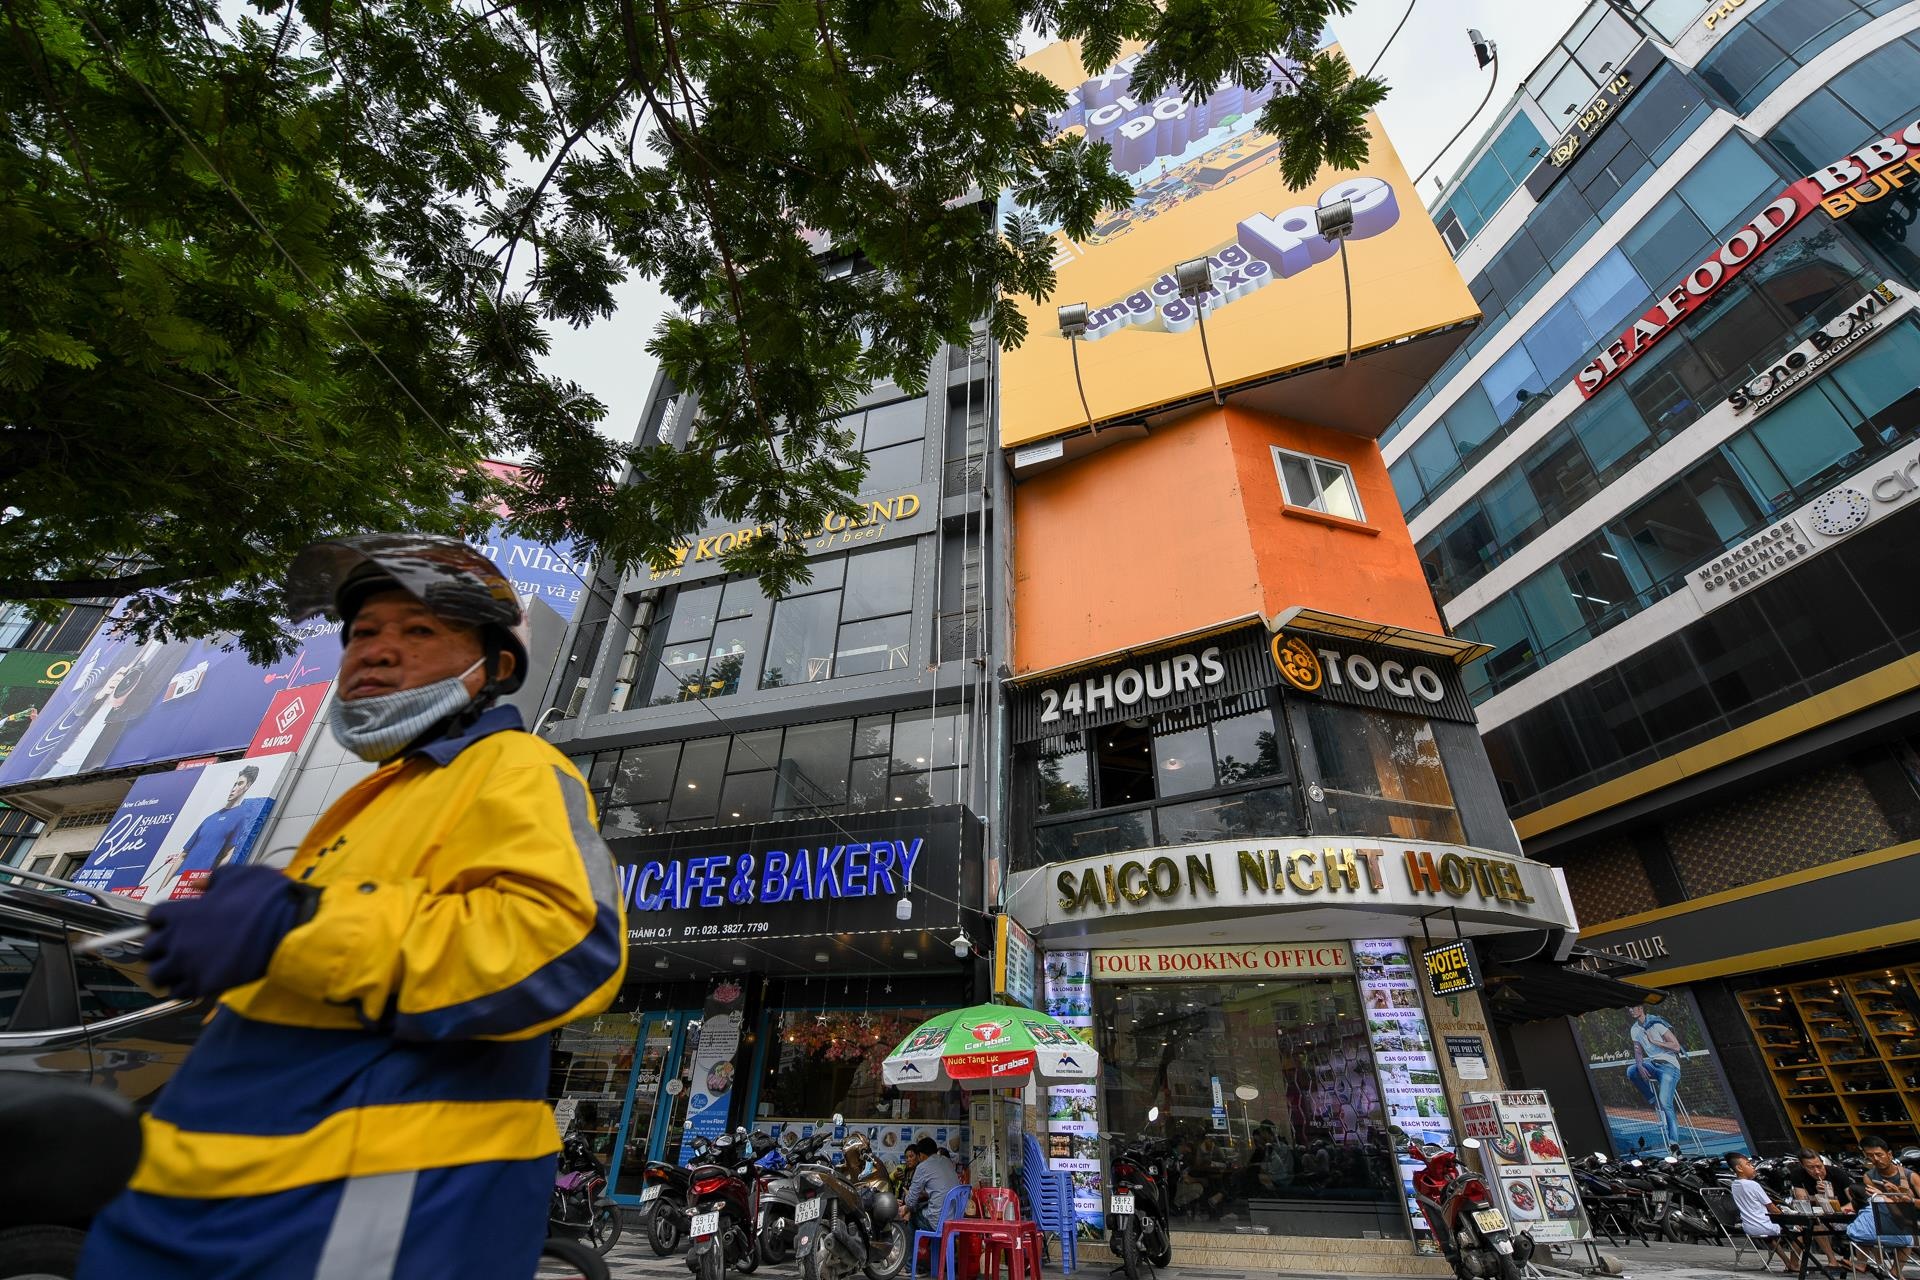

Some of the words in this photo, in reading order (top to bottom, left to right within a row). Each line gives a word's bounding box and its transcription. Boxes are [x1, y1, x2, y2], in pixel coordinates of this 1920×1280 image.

[1607, 74, 1630, 96] Vu
[1238, 177, 1399, 263] be
[1151, 243, 1250, 298] dng
[1219, 260, 1270, 292] xe
[1578, 197, 1797, 393] SEAFOOD
[1753, 369, 1807, 412] Japanese
[1807, 320, 1874, 372] Restaurant
[782, 494, 921, 543] GEND
[816, 531, 838, 549] of
[841, 523, 886, 544] beef
[1698, 521, 1795, 581] WORKSPACE
[1704, 532, 1798, 592] COMMUNITY
[1728, 542, 1809, 593] SERVICES
[546, 584, 566, 598] và
[1040, 646, 1226, 724] 24HOURS
[1318, 648, 1445, 704] TOGO
[261, 734, 293, 749] SAVICO
[122, 801, 135, 809] New
[134, 798, 160, 808] Collection
[134, 825, 148, 837] OF
[140, 813, 175, 827] SHADES
[94, 813, 147, 866] Blue
[760, 838, 924, 903] BAKERY
[1057, 852, 1218, 911] SAIGON
[1237, 847, 1385, 896] NIGHT
[1403, 850, 1536, 905] HOTEL
[627, 927, 656, 939] THÀNH
[657, 926, 673, 938] Q.1
[1095, 955, 1152, 973] TOUR
[1158, 951, 1259, 972] BOOKING
[1264, 947, 1348, 970] OFFICE
[1427, 947, 1468, 976] HOTEL
[1439, 977, 1467, 990] AVAILABLE
[1441, 970, 1459, 981] ROOM
[1445, 995, 1460, 1018] 7
[964, 1035, 1012, 1050] Carabao
[1449, 1045, 1461, 1053] PHI
[1461, 1044, 1473, 1053] PHI
[947, 1055, 967, 1065] Nước
[991, 1057, 1030, 1074] Carabao
[1507, 1094, 1541, 1106] ALACART
